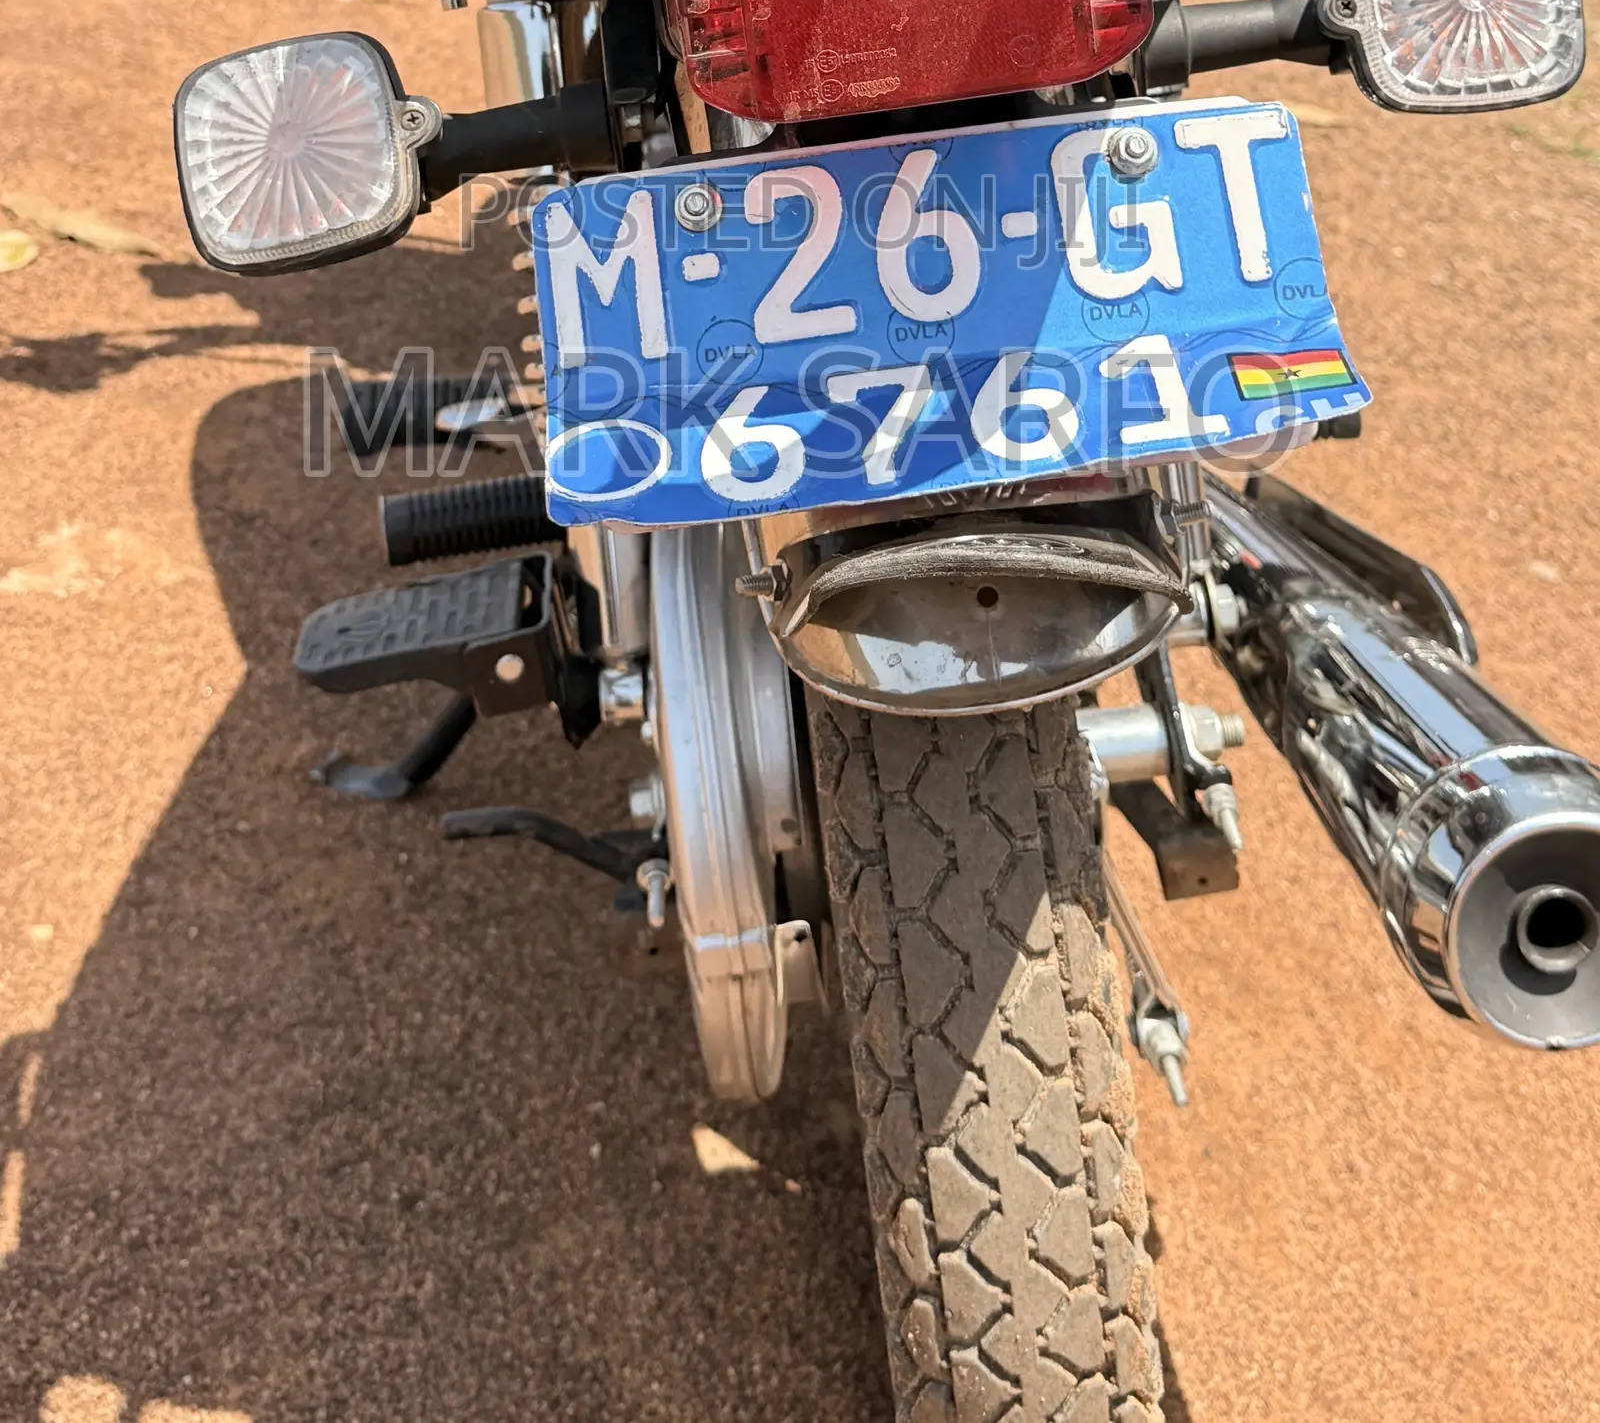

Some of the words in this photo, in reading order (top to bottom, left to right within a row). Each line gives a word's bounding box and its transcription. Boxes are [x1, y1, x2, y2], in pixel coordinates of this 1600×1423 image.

[1089, 301, 1143, 322] DVLA
[894, 321, 948, 343] DVLA
[704, 342, 756, 364] DVLA
[700, 334, 1231, 488] 6761
